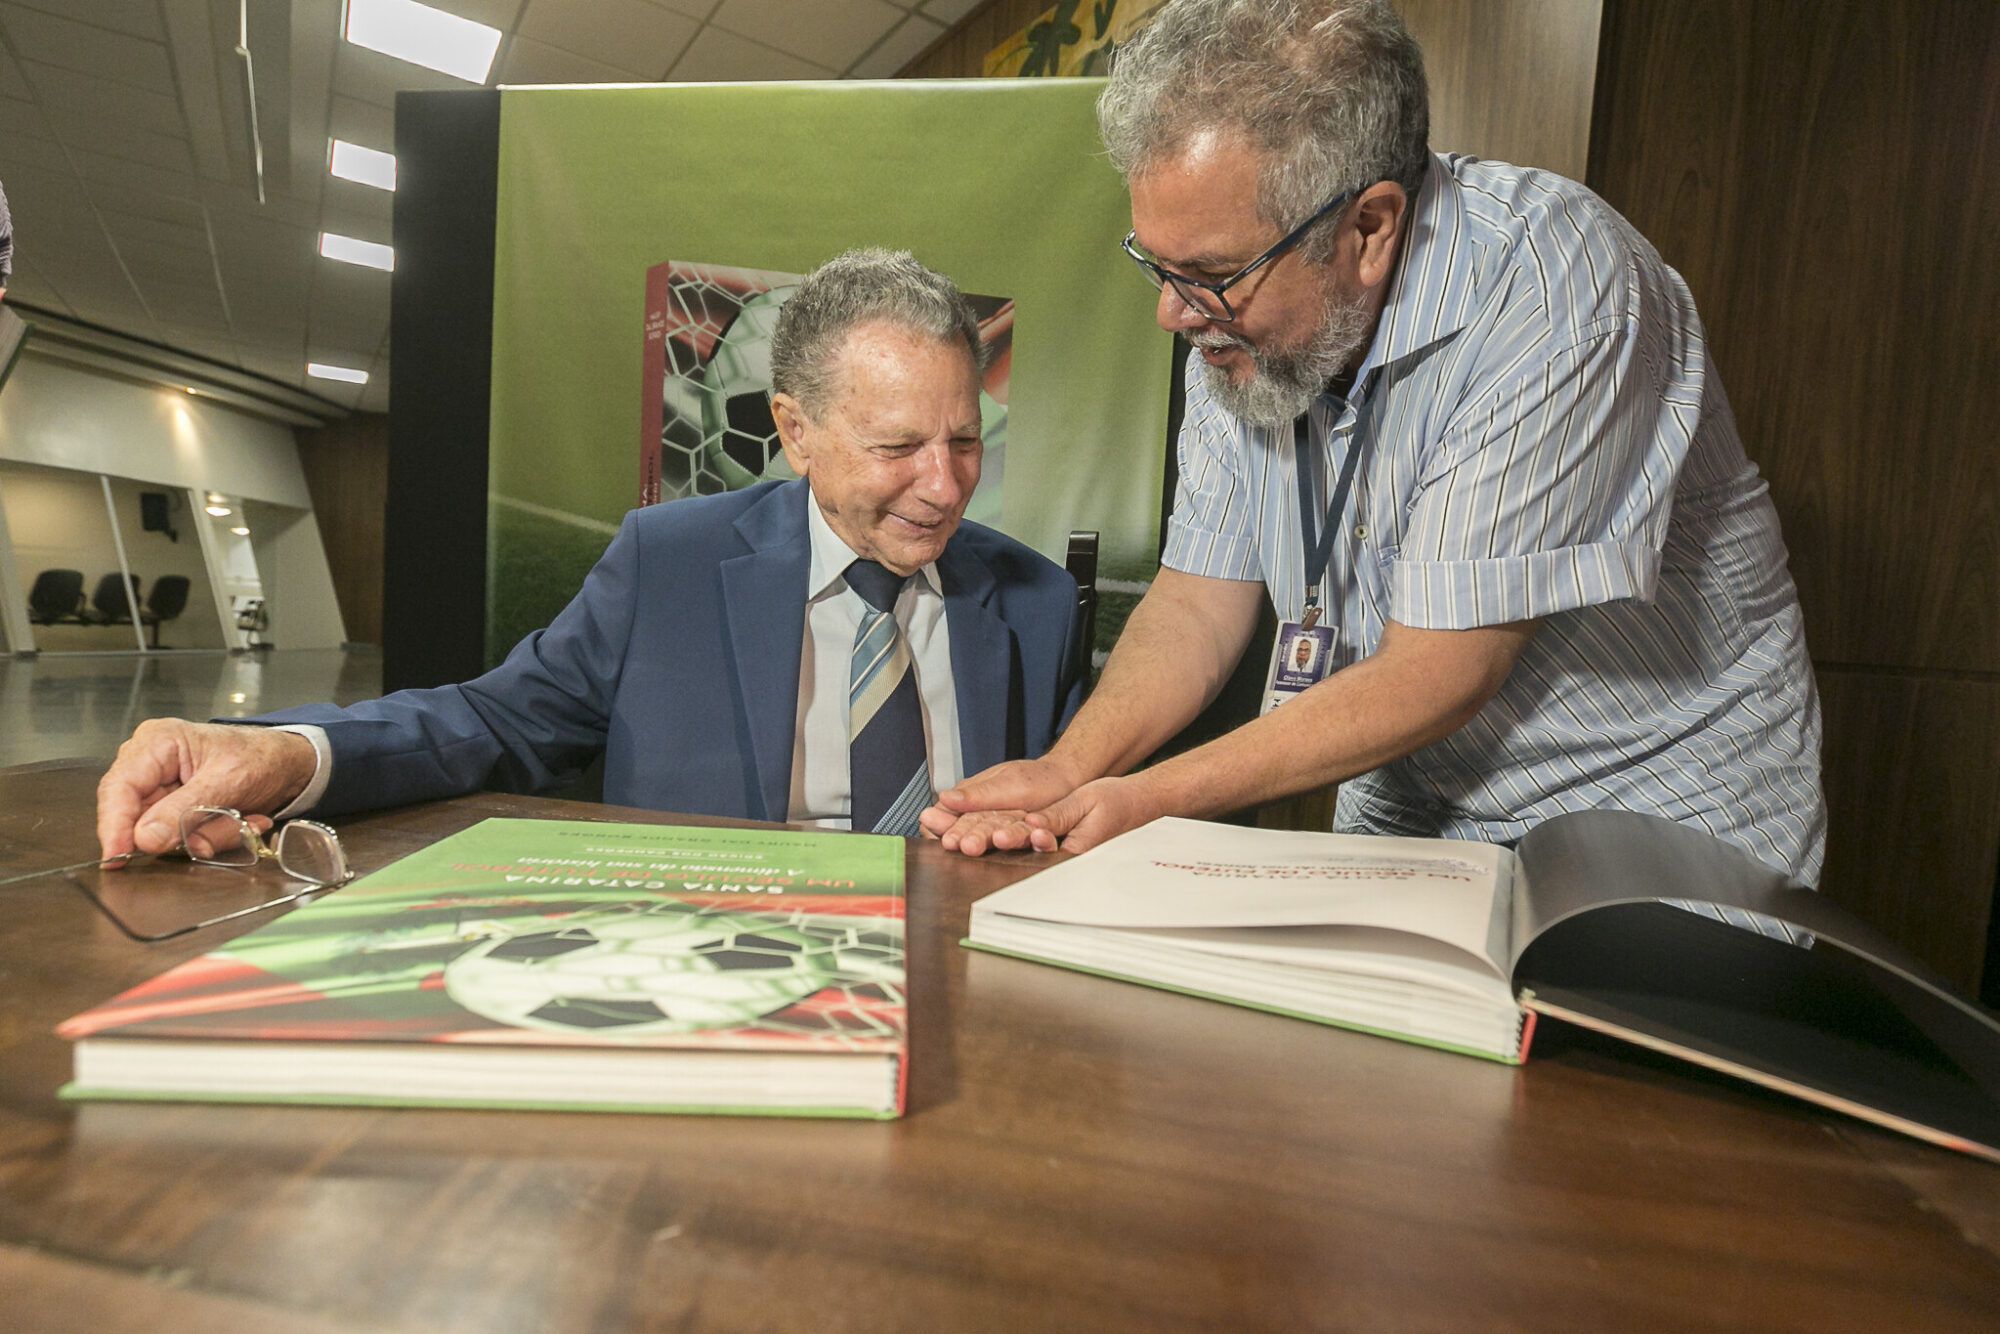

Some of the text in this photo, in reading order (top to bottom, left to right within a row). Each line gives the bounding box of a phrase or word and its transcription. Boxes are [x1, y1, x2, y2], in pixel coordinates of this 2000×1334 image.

[517, 857, 601, 868] história
[649, 863, 676, 871] da
[1150, 860, 1257, 873] FUTEBOL
[449, 863, 598, 876] FUTEBOL
[607, 870, 652, 879] DE
[681, 864, 780, 876] dimensão
[787, 868, 805, 876] A
[1193, 871, 1311, 880] CATARINA
[1428, 873, 1471, 882] UM
[505, 874, 785, 895] SANTA CATARINA
[806, 878, 855, 888] UM
